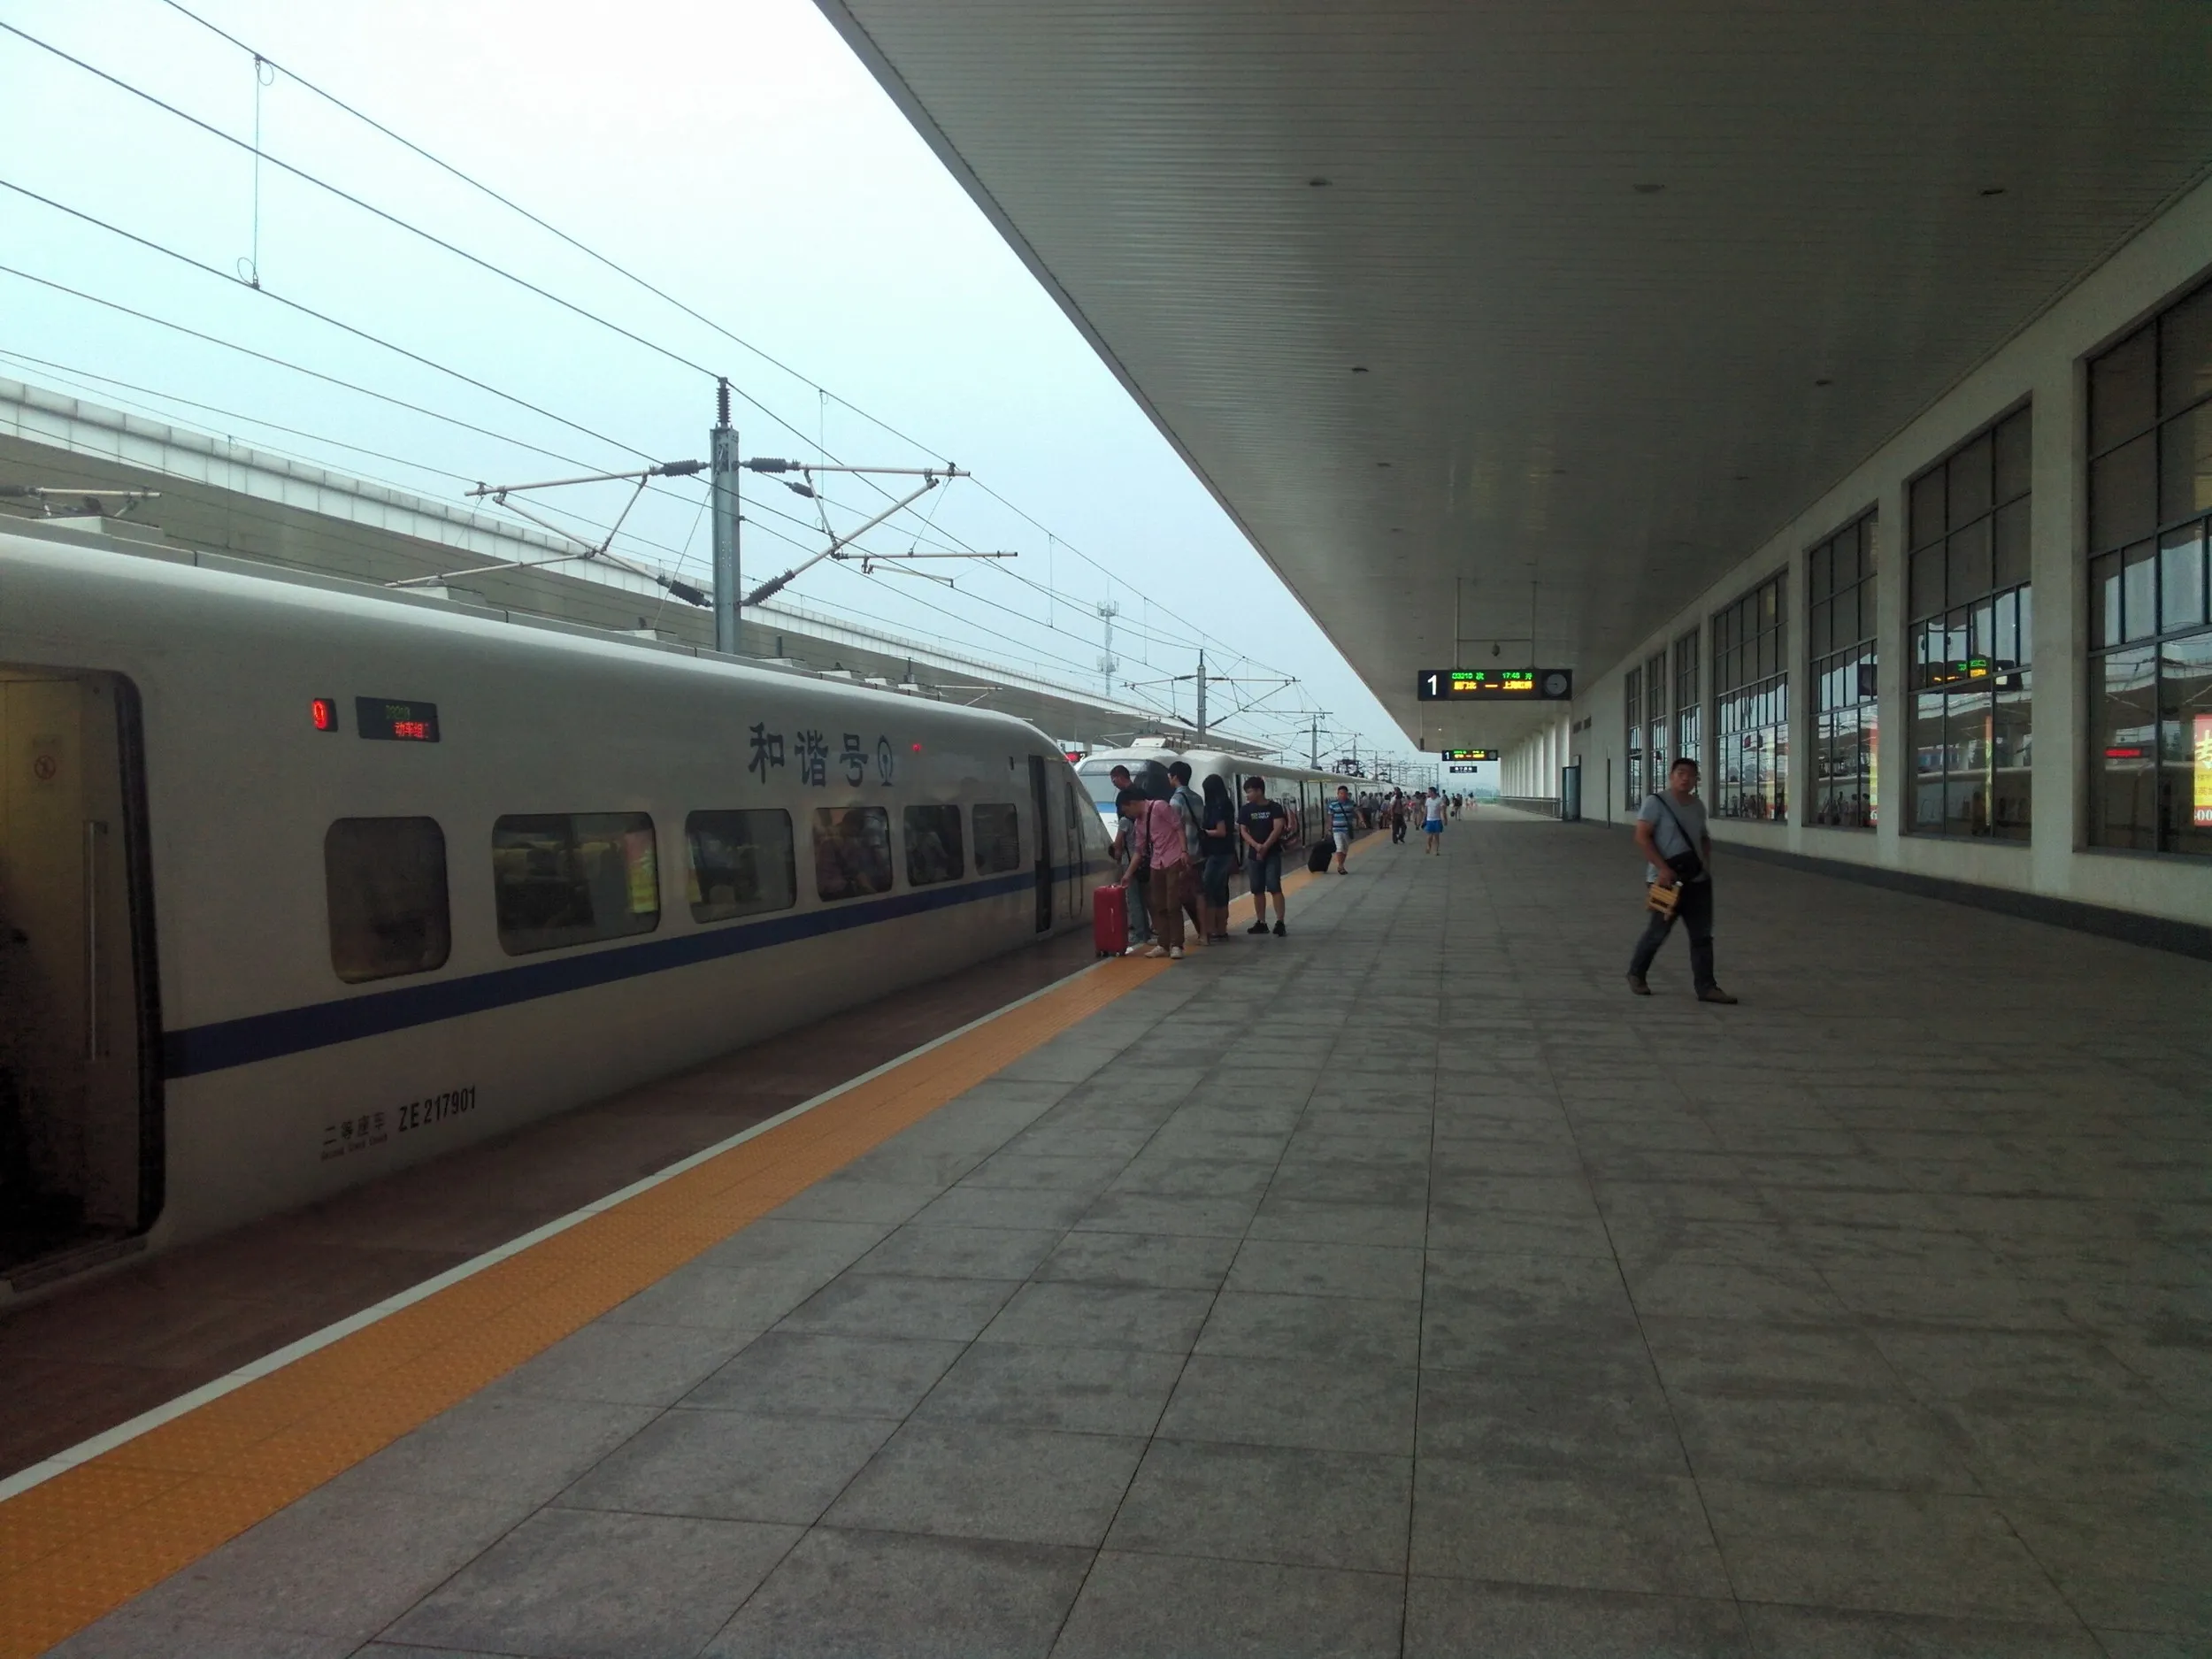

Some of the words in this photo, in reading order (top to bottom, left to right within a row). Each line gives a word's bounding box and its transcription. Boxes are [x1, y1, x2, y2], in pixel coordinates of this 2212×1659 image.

[1427, 674, 1437, 695] 1
[748, 722, 869, 787] 和谐号
[1445, 751, 1450, 760] 1
